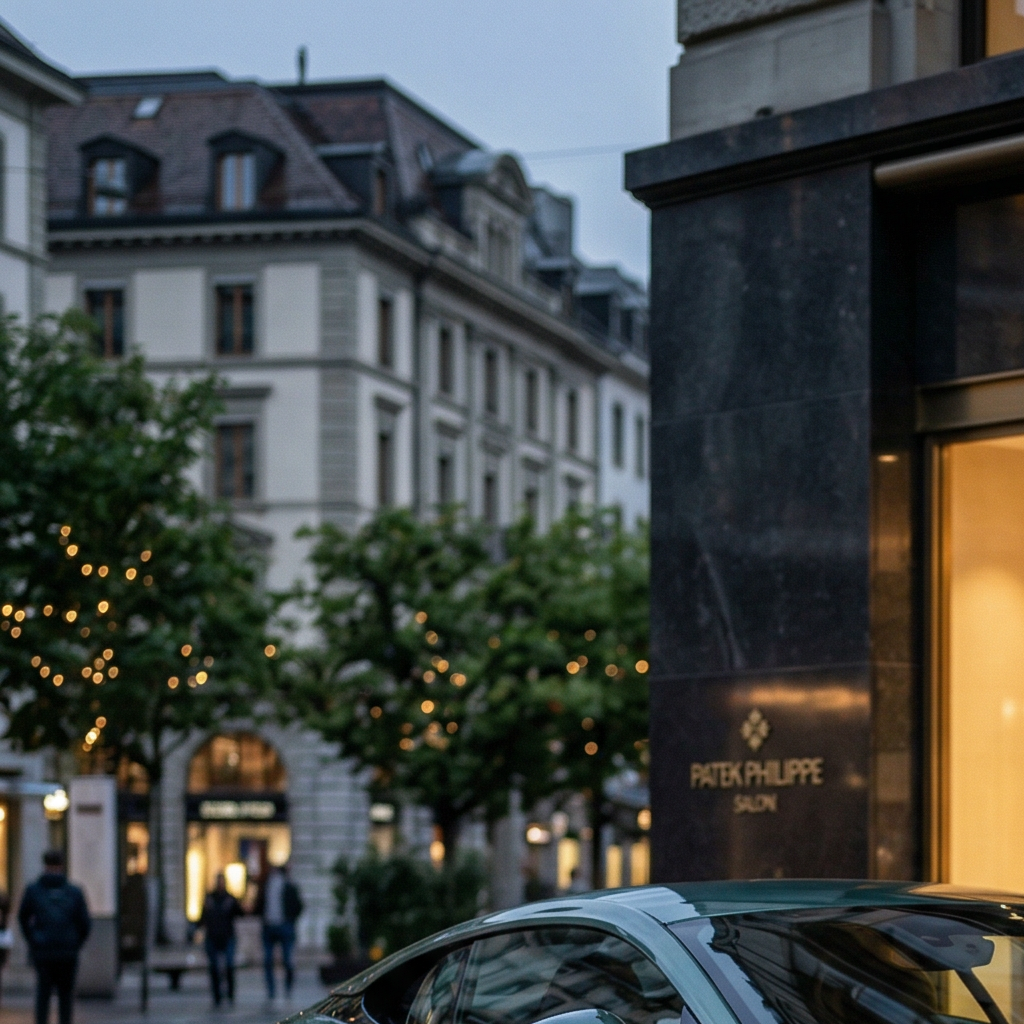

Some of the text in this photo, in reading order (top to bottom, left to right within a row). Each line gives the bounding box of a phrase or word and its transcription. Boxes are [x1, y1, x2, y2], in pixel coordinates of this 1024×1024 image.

[690, 757, 824, 788] PATEK PHILIPPE
[733, 793, 778, 814] SALON
